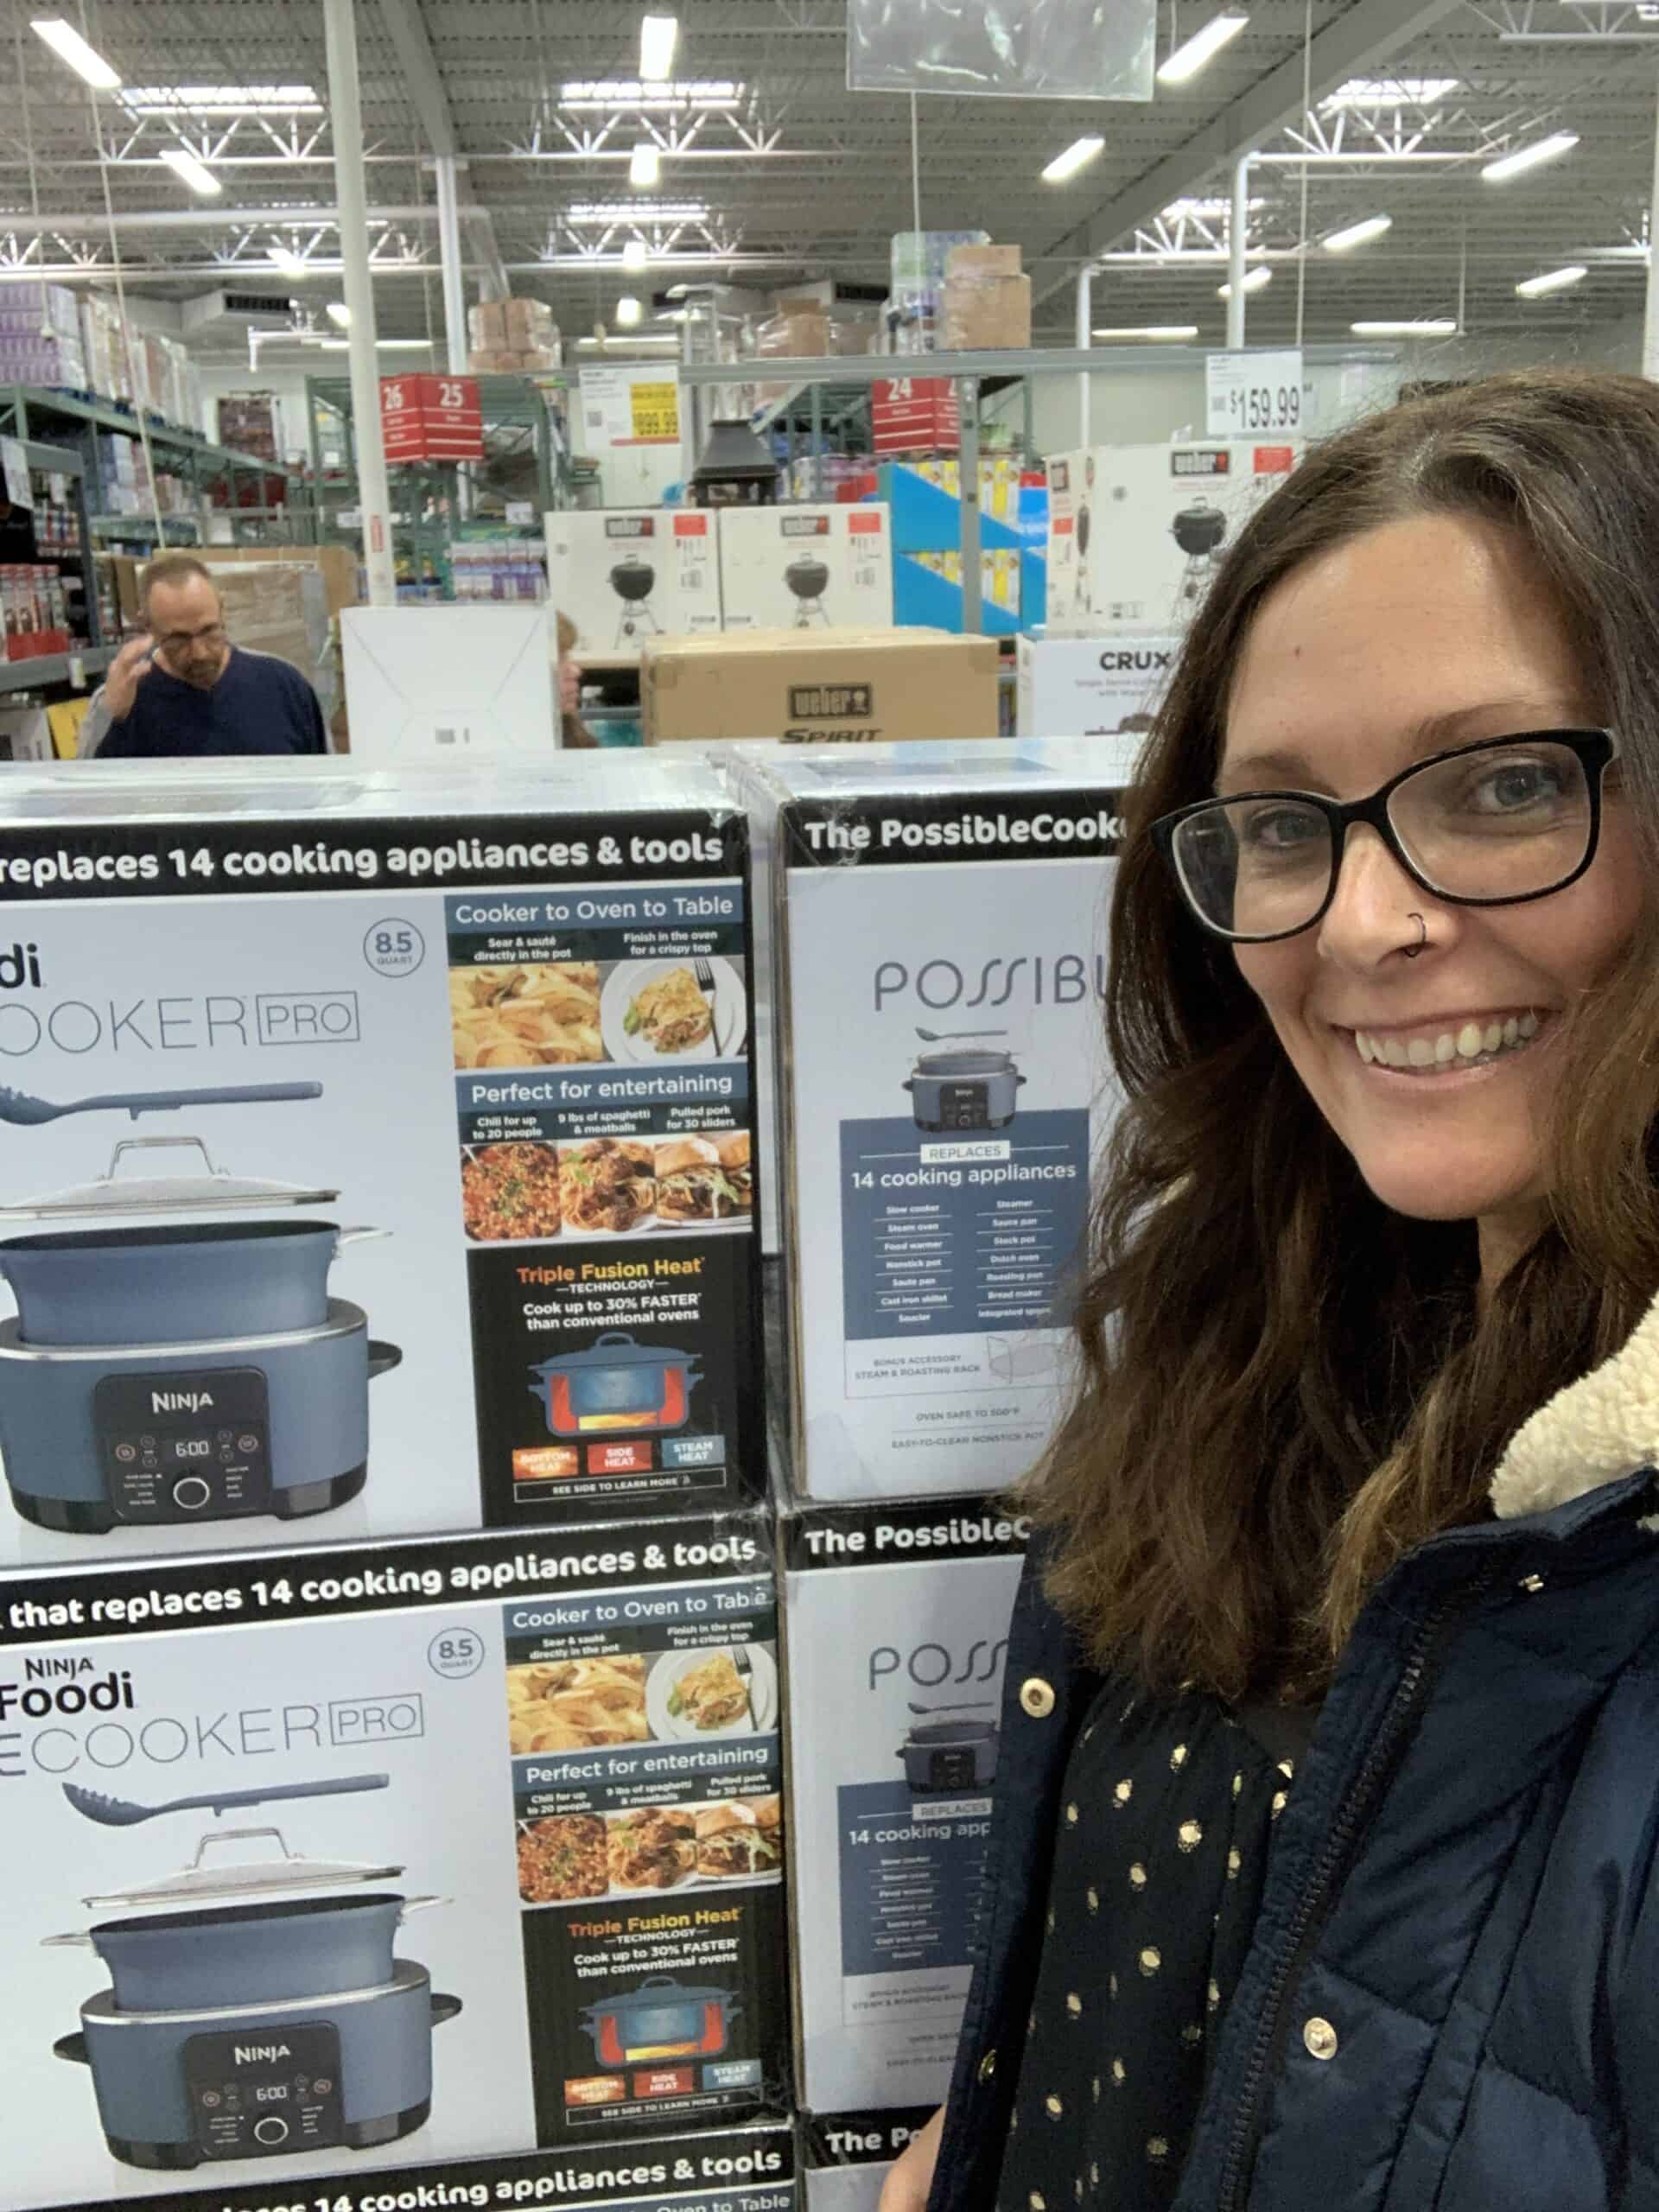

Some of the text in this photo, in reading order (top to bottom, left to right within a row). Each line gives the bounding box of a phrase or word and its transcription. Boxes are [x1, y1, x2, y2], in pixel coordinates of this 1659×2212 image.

[383, 384, 404, 410] 26
[438, 383, 463, 408] 25
[887, 377, 912, 402] 24
[1230, 385, 1300, 429] $159.99
[1099, 651, 1171, 671] CRUX
[804, 820, 871, 850] The
[0, 833, 724, 888] replaces 14 cooking appliances & tools
[455, 895, 734, 925] Cooker to Oven to Table
[487, 937, 513, 949] Sear
[516, 937, 524, 948] &
[623, 930, 718, 944] Finish in the oven
[474, 948, 572, 963] directly in the pot
[630, 943, 712, 957] for a crispy top
[266, 1001, 352, 1035] PRO
[472, 1074, 734, 1103] Perfect for entertaining
[477, 1116, 537, 1129] Chili for up
[557, 1109, 652, 1125] 9 lbs of spaghetti
[666, 1116, 736, 1130] for 30 sliders
[671, 1104, 732, 1119] Pulled pork
[473, 1127, 543, 1141] to 20 people
[574, 1122, 637, 1135] & meatballs
[929, 1145, 1001, 1160] REPLACES
[851, 1163, 1077, 1189] 14 cooking appliances
[516, 1257, 704, 1286] Triple Fusion Heat
[569, 1278, 656, 1294] TECHNOLOGY
[523, 1302, 562, 1316] Cook
[564, 1302, 585, 1315] up
[588, 1300, 604, 1313] to
[606, 1297, 638, 1311] 30%
[527, 1309, 700, 1332] than conventional ovens
[151, 1391, 214, 1414] NINJA
[606, 1446, 634, 1459] SIDE
[673, 1441, 714, 1453] STEAM
[677, 1451, 710, 1463] HEAT
[604, 1456, 636, 1468] HEAT
[552, 1476, 679, 1496] SEE SIDE TO LEARN MORE
[804, 1516, 1033, 1554] The PossibleC
[10, 1536, 757, 1629] that replaces 14 cooking appliances & tools
[512, 1608, 589, 1630] Cooker
[595, 1604, 619, 1622] to
[624, 1599, 680, 1619] Oven
[684, 1597, 708, 1614] to
[24, 1657, 95, 1682] NINJA
[869, 1638, 1009, 1690] POSS
[0, 1670, 134, 1721] Foodi
[338, 1703, 416, 1737] PRO
[526, 1746, 769, 1784] Perfect for entertaining
[920, 1802, 987, 1816] REPLACES
[849, 1829, 869, 1846] 14
[874, 1823, 951, 1844] cooking
[568, 1907, 741, 1939] Triple Fusion Heat
[616, 1928, 696, 1945] TECHNOLOGY
[573, 1951, 609, 1966] Cook
[612, 1950, 630, 1964] up
[632, 1948, 648, 1960] to
[650, 1944, 681, 1958] 30%
[577, 1952, 738, 1978] than conventional ovens
[234, 2044, 291, 2066] NINJA
[824, 2131, 882, 2155] The
[360, 2183, 488, 2212] cooking
[496, 2161, 666, 2201] appliances
[673, 2158, 696, 2180] &
[702, 2150, 781, 2177] tools
[737, 2194, 791, 2211] Table
